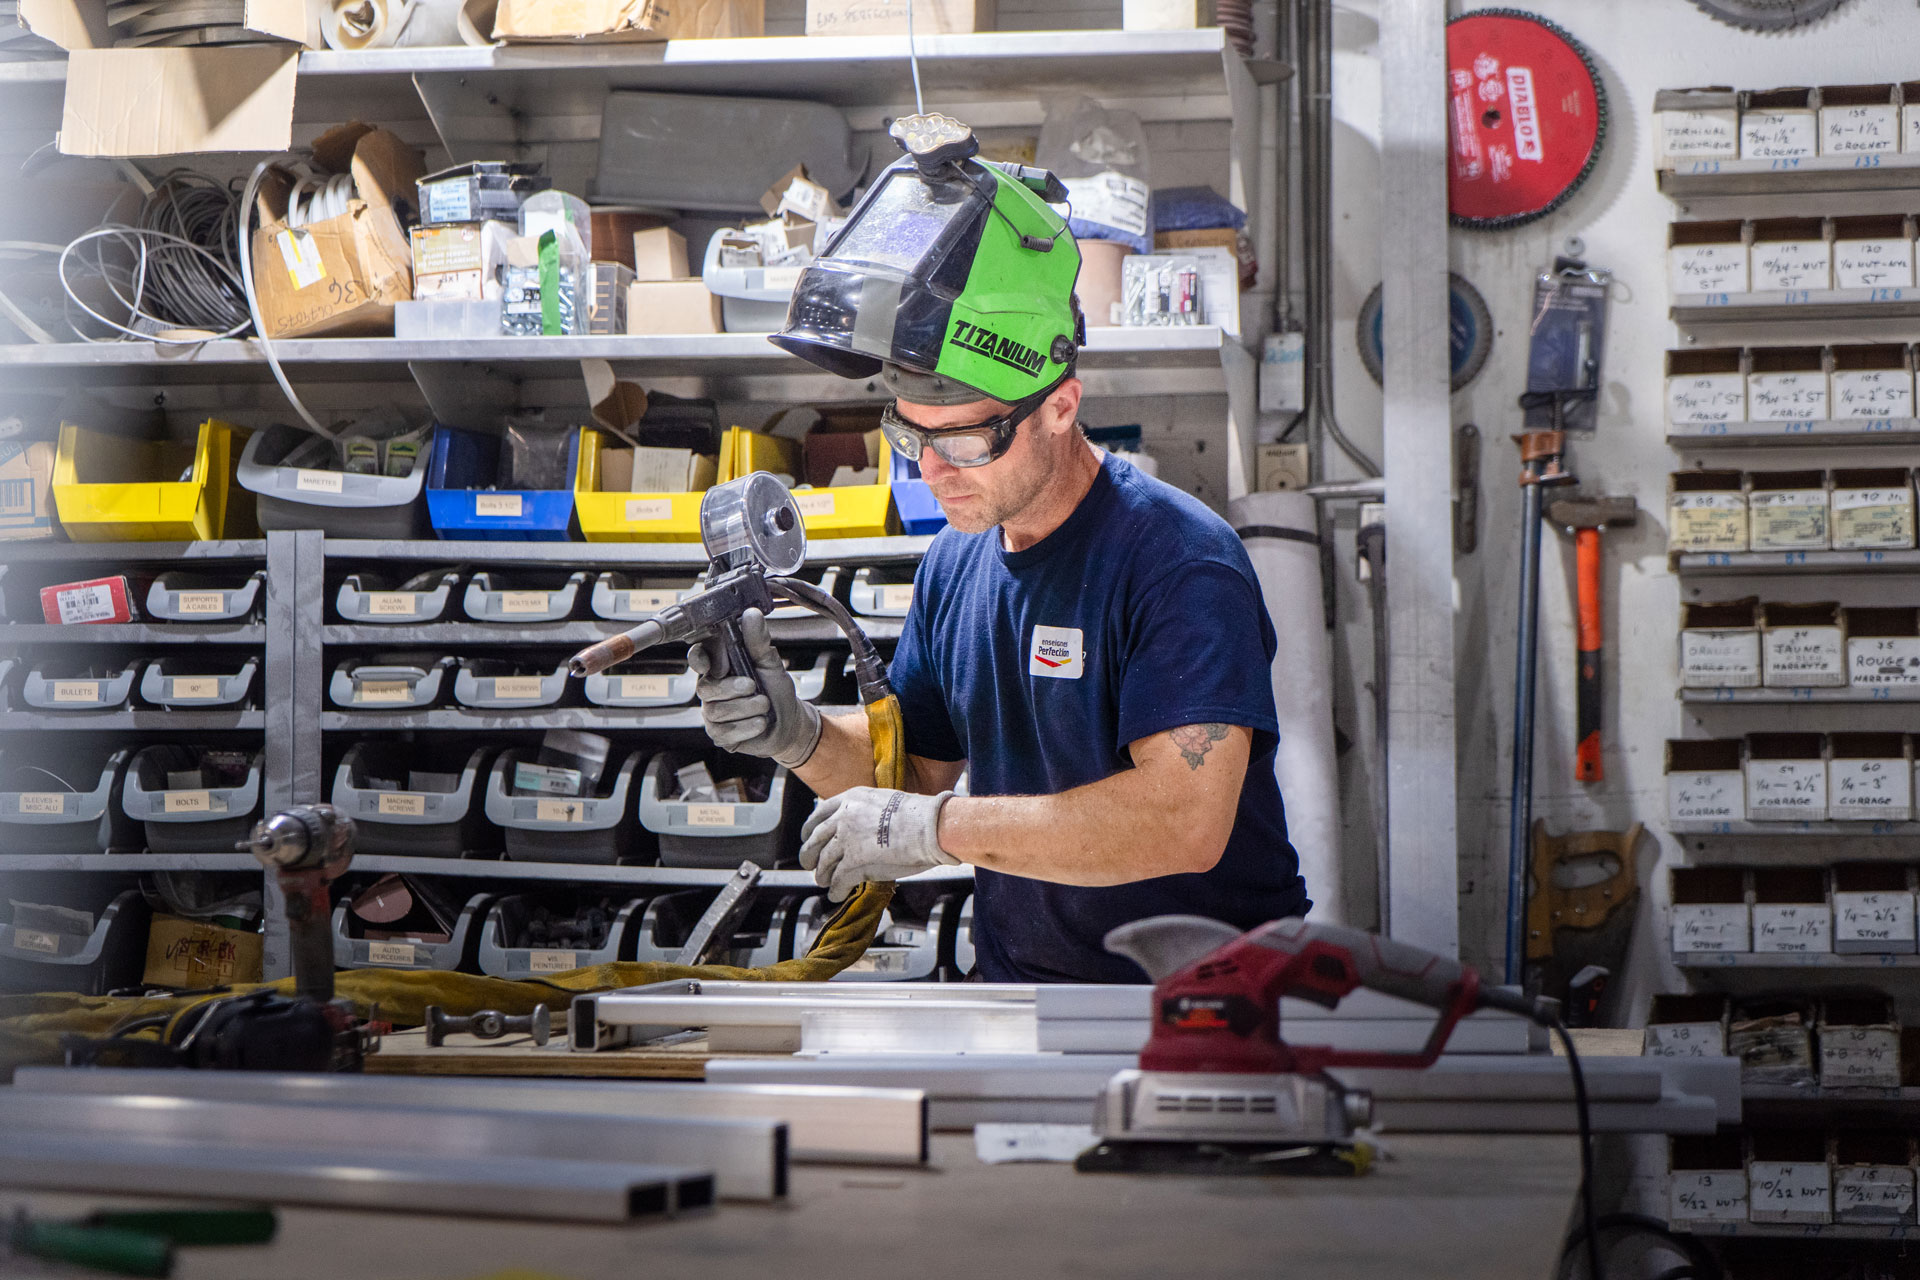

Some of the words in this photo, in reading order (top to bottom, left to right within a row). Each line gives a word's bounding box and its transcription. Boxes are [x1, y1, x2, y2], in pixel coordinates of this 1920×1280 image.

[1511, 74, 1533, 137] DIABLO
[1855, 155, 1880, 168] 135
[1785, 290, 1809, 304] 119
[1871, 288, 1902, 304] 120
[952, 320, 1047, 373] TITANIUM
[1785, 421, 1813, 433] 104
[1866, 419, 1892, 431] 105
[303, 477, 337, 487] MARETTES
[508, 599, 529, 607] BOLTS
[1038, 646, 1070, 658] Perfection
[1689, 645, 1741, 657] ORANGE
[1856, 654, 1905, 667] ROUGE
[1861, 763, 1881, 773] 60
[175, 798, 199, 806] BOLTS
[382, 946, 401, 954] AUTO
[1862, 1169, 1878, 1179] 15
[1802, 1187, 1828, 1197] NUT
